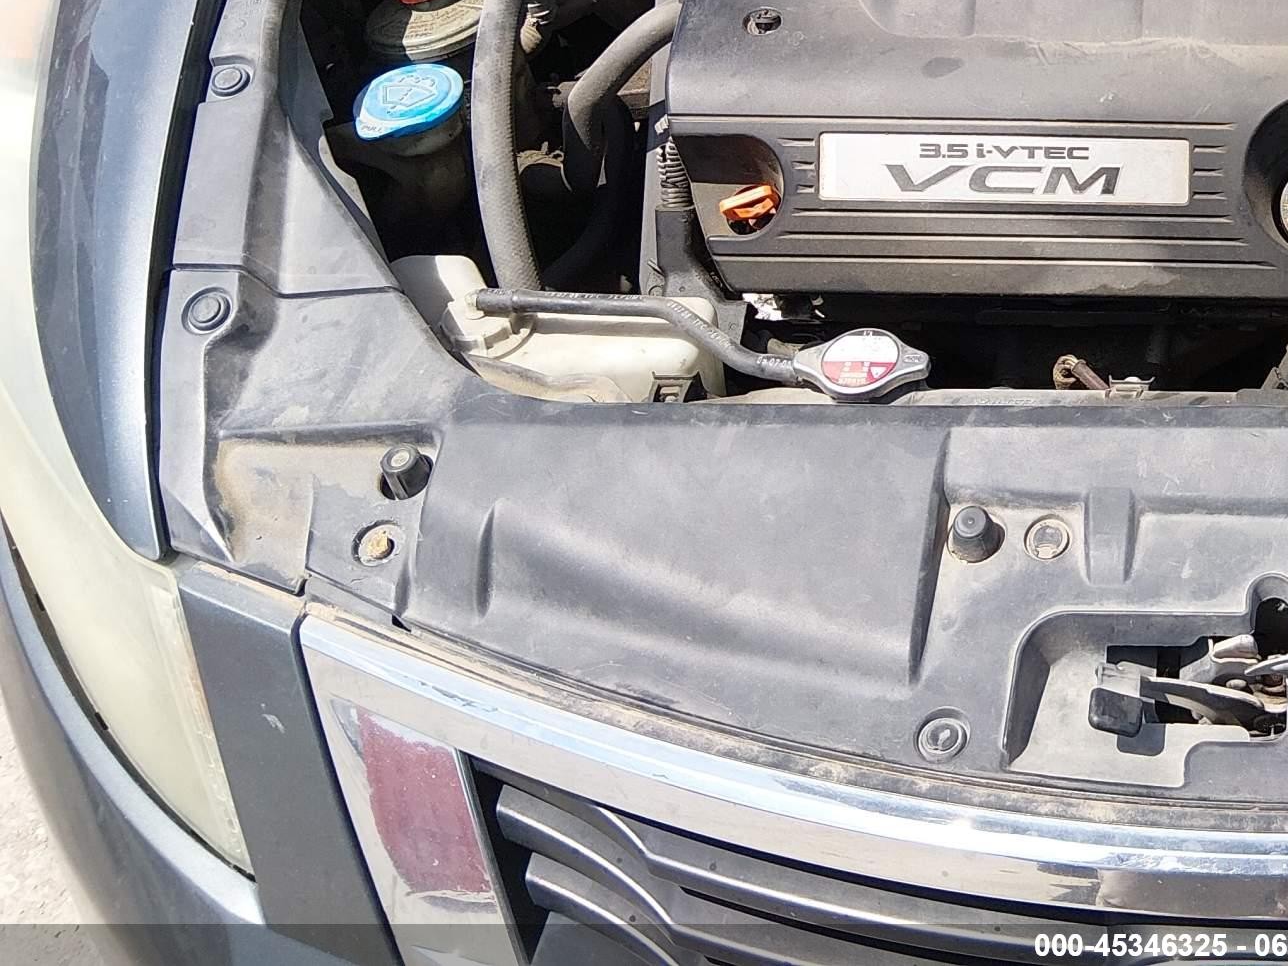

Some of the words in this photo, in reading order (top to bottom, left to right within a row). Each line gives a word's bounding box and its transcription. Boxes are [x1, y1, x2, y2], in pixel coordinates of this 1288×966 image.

[919, 142, 968, 158] 3.5
[976, 142, 1090, 160] i-VTEC
[884, 163, 1123, 195] VCM
